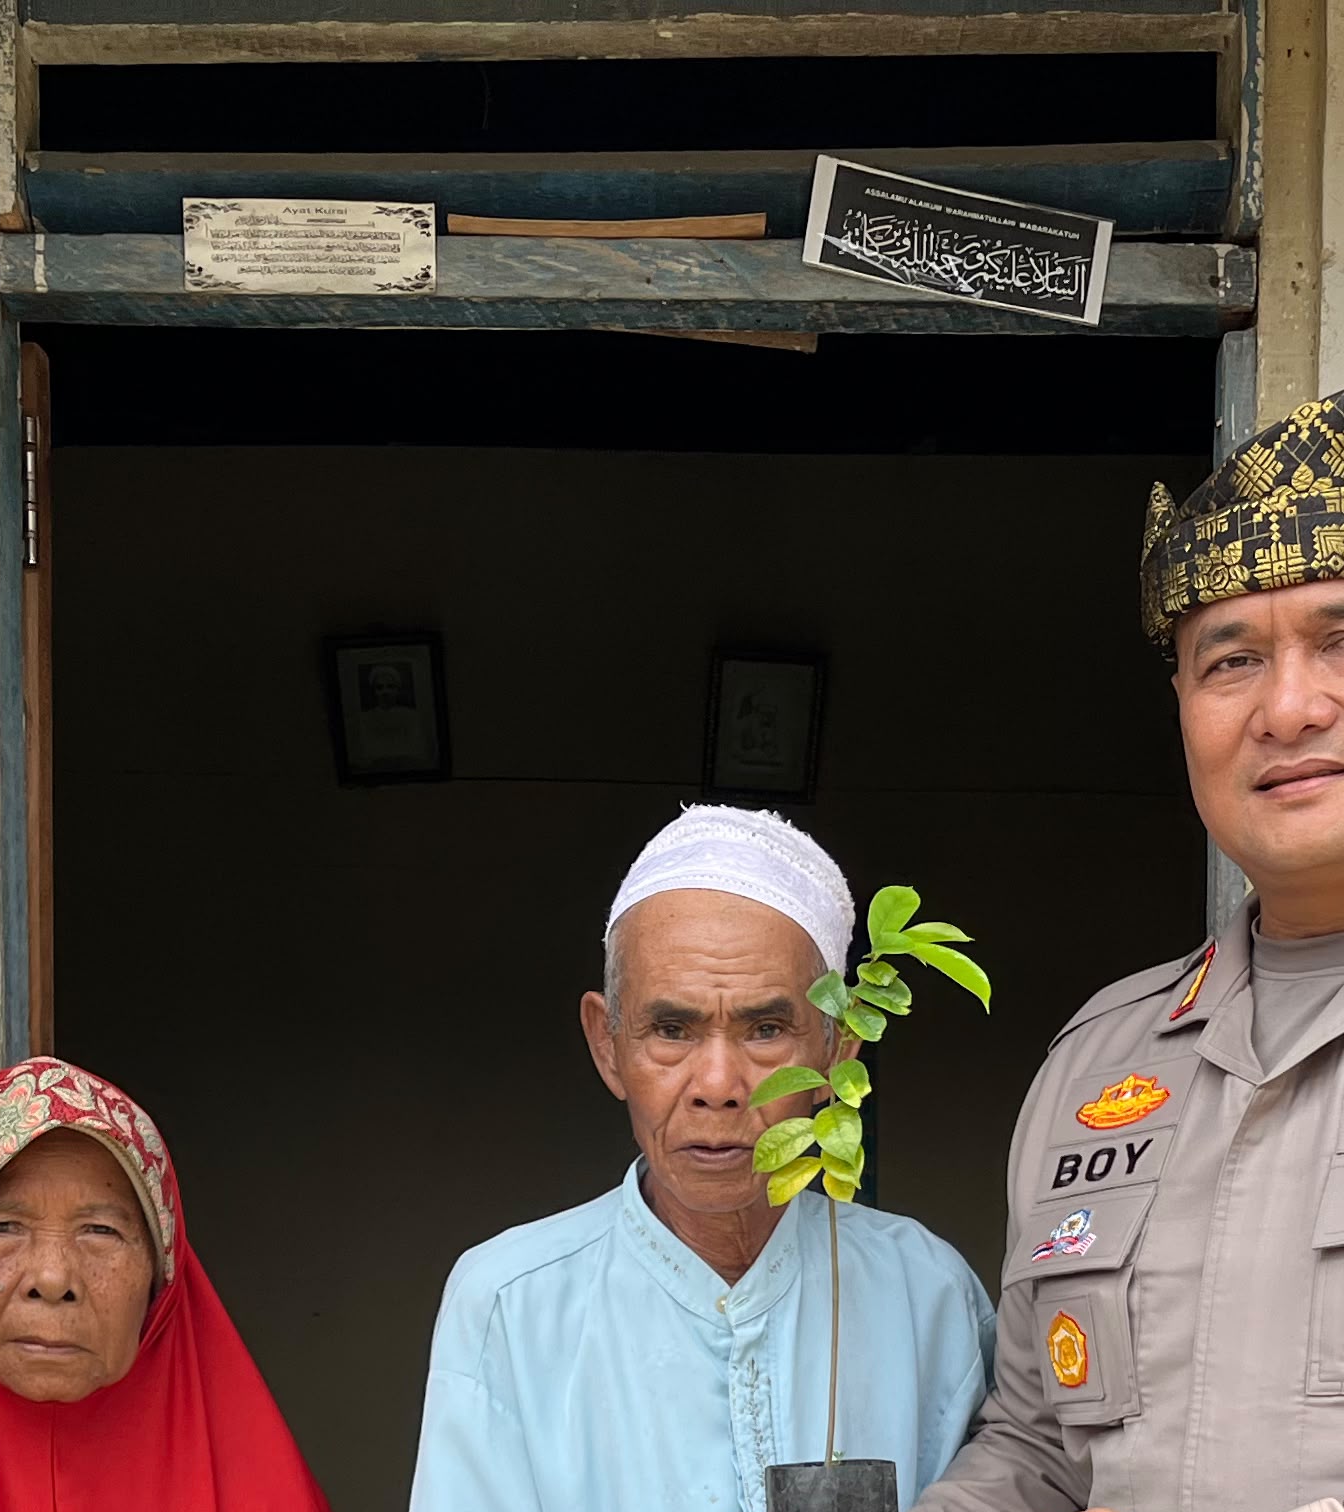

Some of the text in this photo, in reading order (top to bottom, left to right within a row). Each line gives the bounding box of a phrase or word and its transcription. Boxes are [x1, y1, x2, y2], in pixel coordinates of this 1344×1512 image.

[282, 207, 348, 216] Ayat Kursi
[1051, 1137, 1154, 1191] BOY
